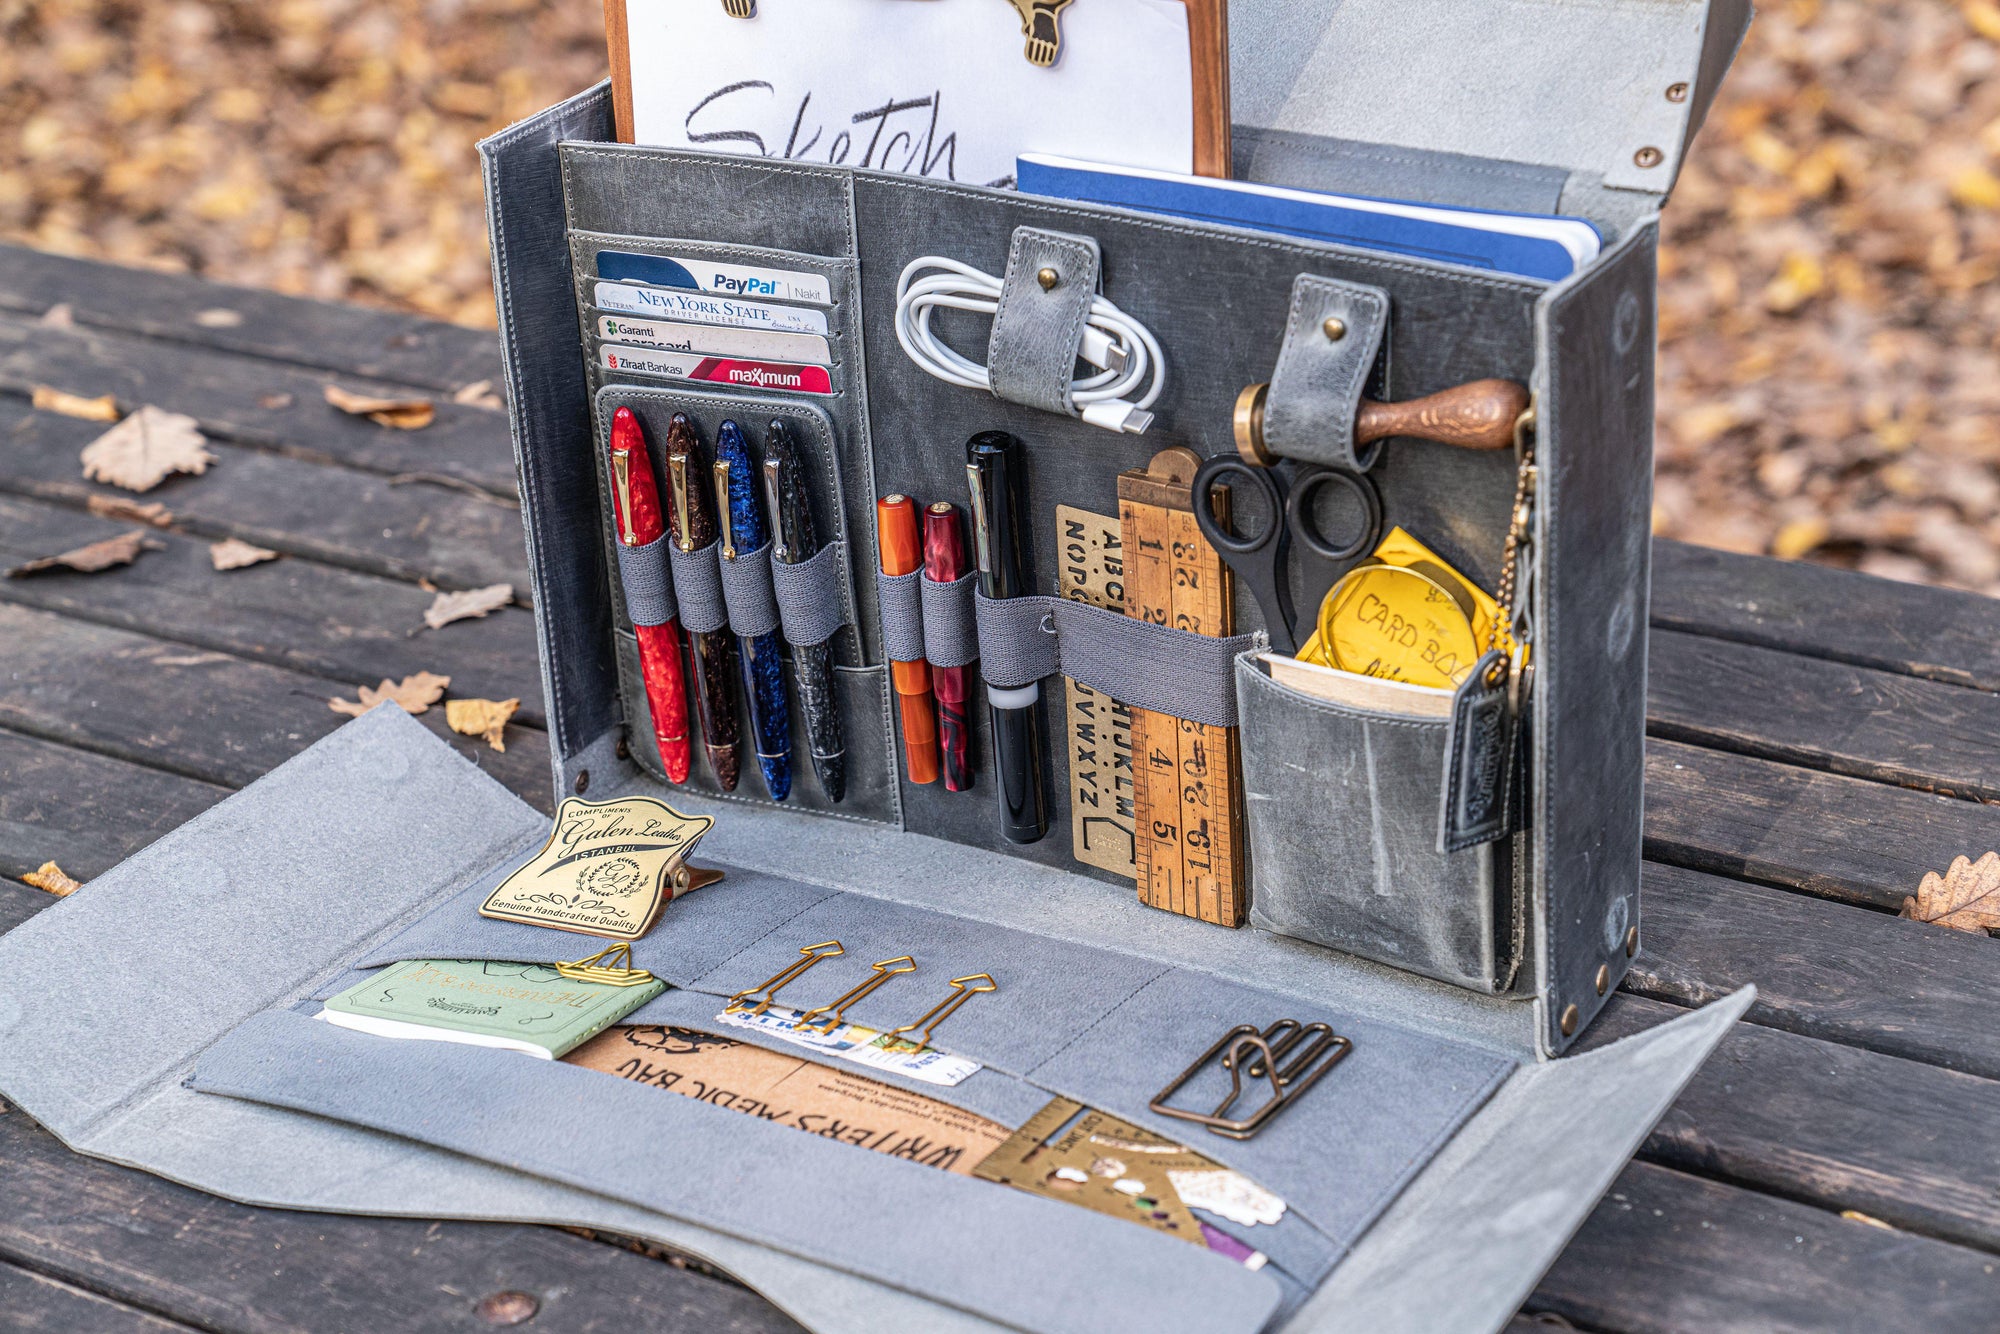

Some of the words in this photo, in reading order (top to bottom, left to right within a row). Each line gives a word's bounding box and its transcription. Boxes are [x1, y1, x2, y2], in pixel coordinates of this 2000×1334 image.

[685, 79, 957, 181] Sketch
[794, 287, 821, 301] Nakit
[663, 308, 700, 319] DRIVER
[705, 314, 746, 326] LICENSE
[723, 301, 771, 321] STATE
[618, 323, 655, 337] Garanti
[619, 357, 647, 370] Ziraat
[647, 361, 683, 375] Bankası
[1356, 592, 1419, 649] CARD
[567, 807, 633, 819] COMPLIMENTS
[557, 815, 634, 859] Galen
[634, 818, 686, 843] Leather
[491, 898, 532, 913] Genuine
[533, 905, 598, 925] Handcrafted
[598, 916, 638, 932] Quality
